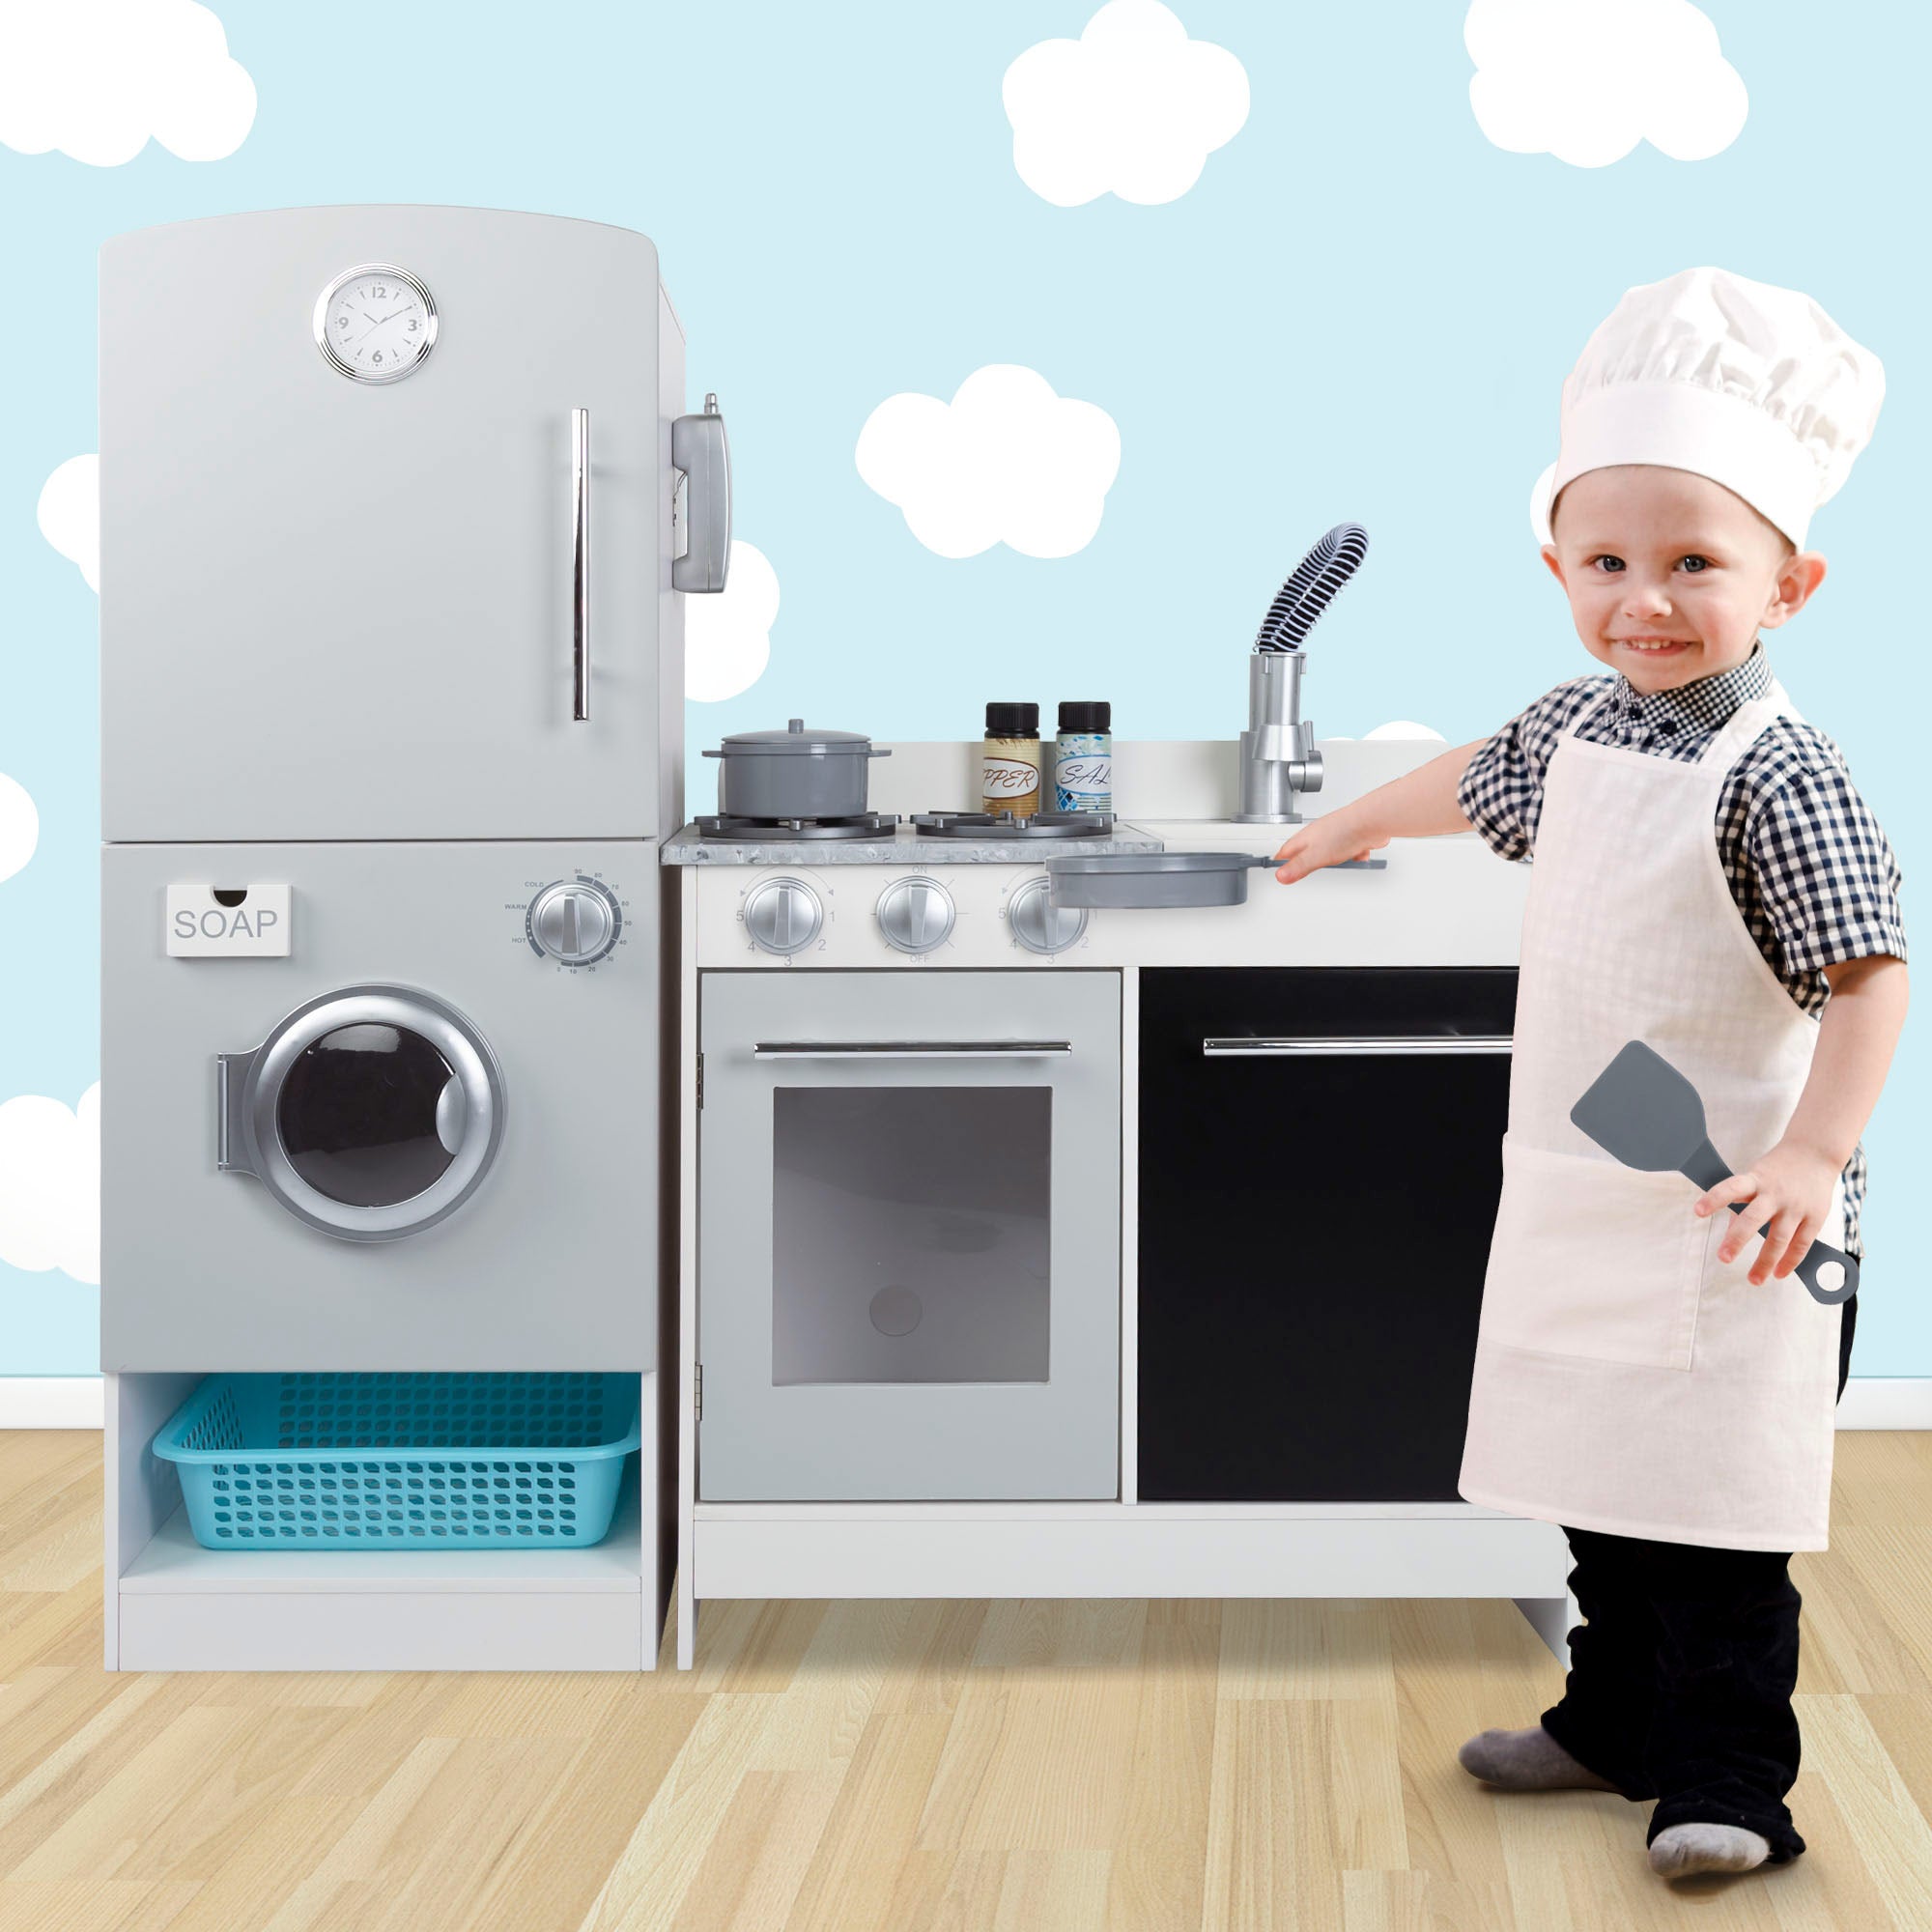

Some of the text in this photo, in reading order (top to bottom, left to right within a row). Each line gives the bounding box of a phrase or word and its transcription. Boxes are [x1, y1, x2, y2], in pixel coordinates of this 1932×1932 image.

[372, 286, 386, 298] 12
[338, 316, 350, 329] 9
[408, 319, 417, 331] 3
[372, 350, 383, 363] 6
[1061, 764, 1111, 784] SAL
[912, 866, 927, 874] ON
[736, 910, 745, 922] 5
[829, 911, 836, 922] 1
[998, 907, 1007, 920] 5
[174, 910, 278, 939] SOAP
[748, 940, 756, 952] 4
[817, 939, 827, 951] 2
[1081, 936, 1090, 949] 2
[783, 954, 793, 967] 3
